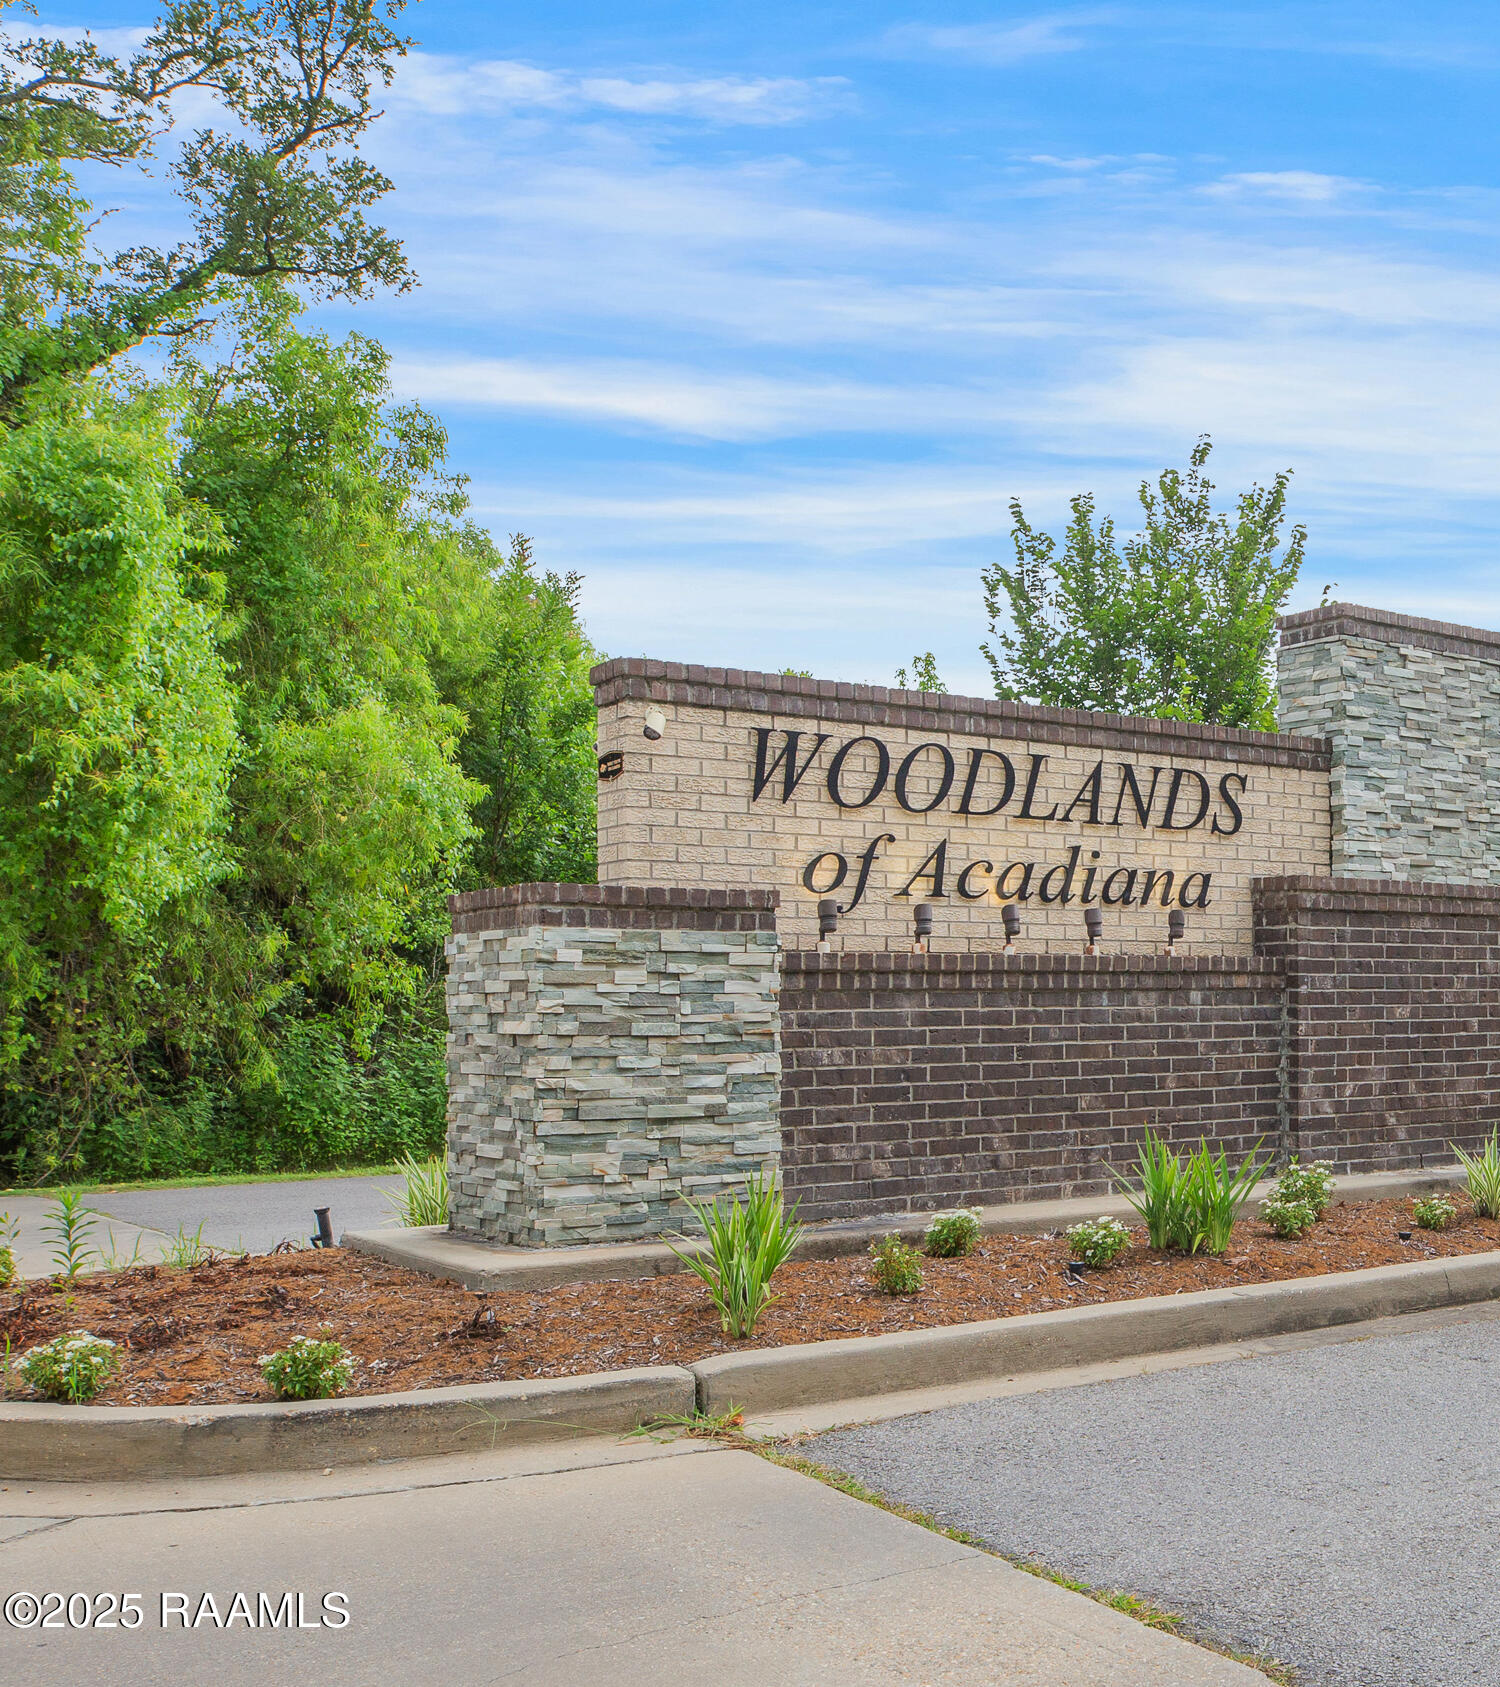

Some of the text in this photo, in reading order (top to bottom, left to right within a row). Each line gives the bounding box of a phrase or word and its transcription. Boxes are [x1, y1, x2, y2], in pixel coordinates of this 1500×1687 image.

[750, 727, 1248, 835] WOODLANDS
[803, 833, 1212, 914] of Acadiana
